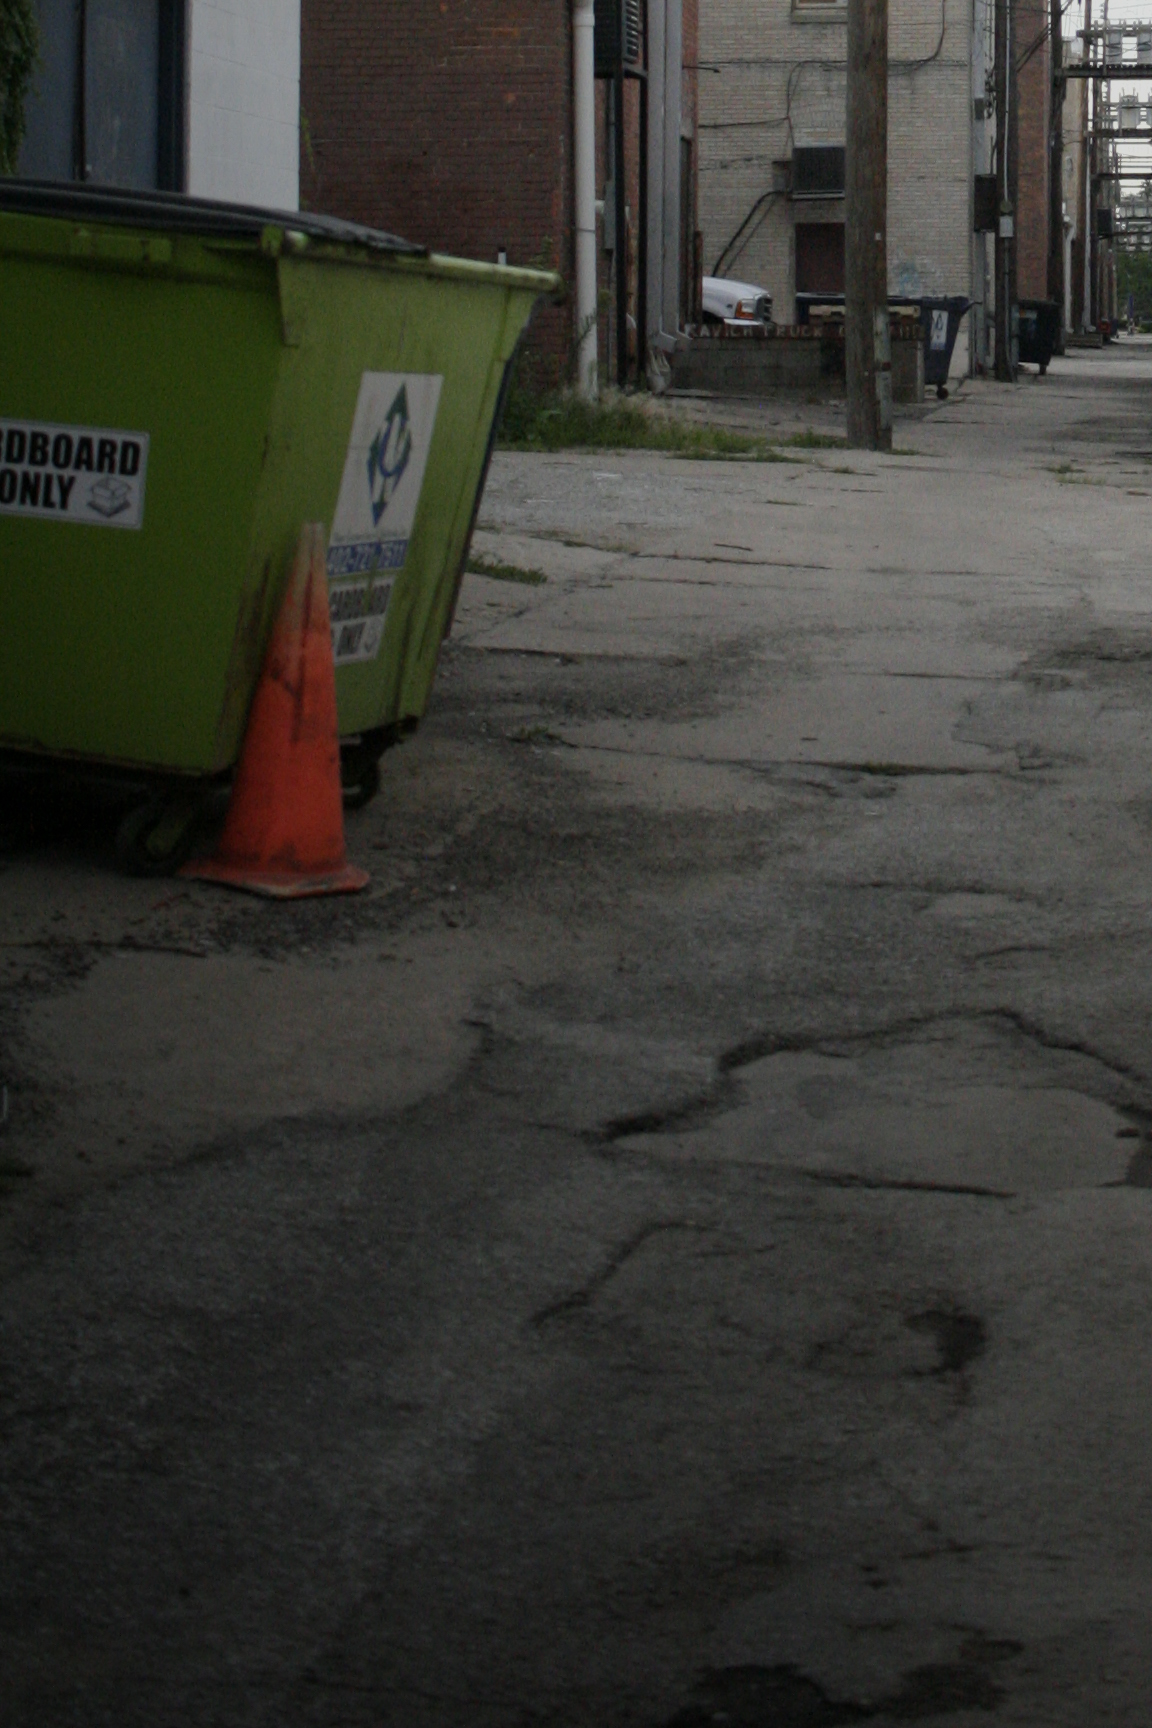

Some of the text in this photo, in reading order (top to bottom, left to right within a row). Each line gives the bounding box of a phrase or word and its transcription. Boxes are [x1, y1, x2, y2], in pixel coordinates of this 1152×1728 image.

[0, 428, 141, 476] DBOARD
[0, 469, 76, 510] ONLY
[330, 585, 391, 621] CARDBARD
